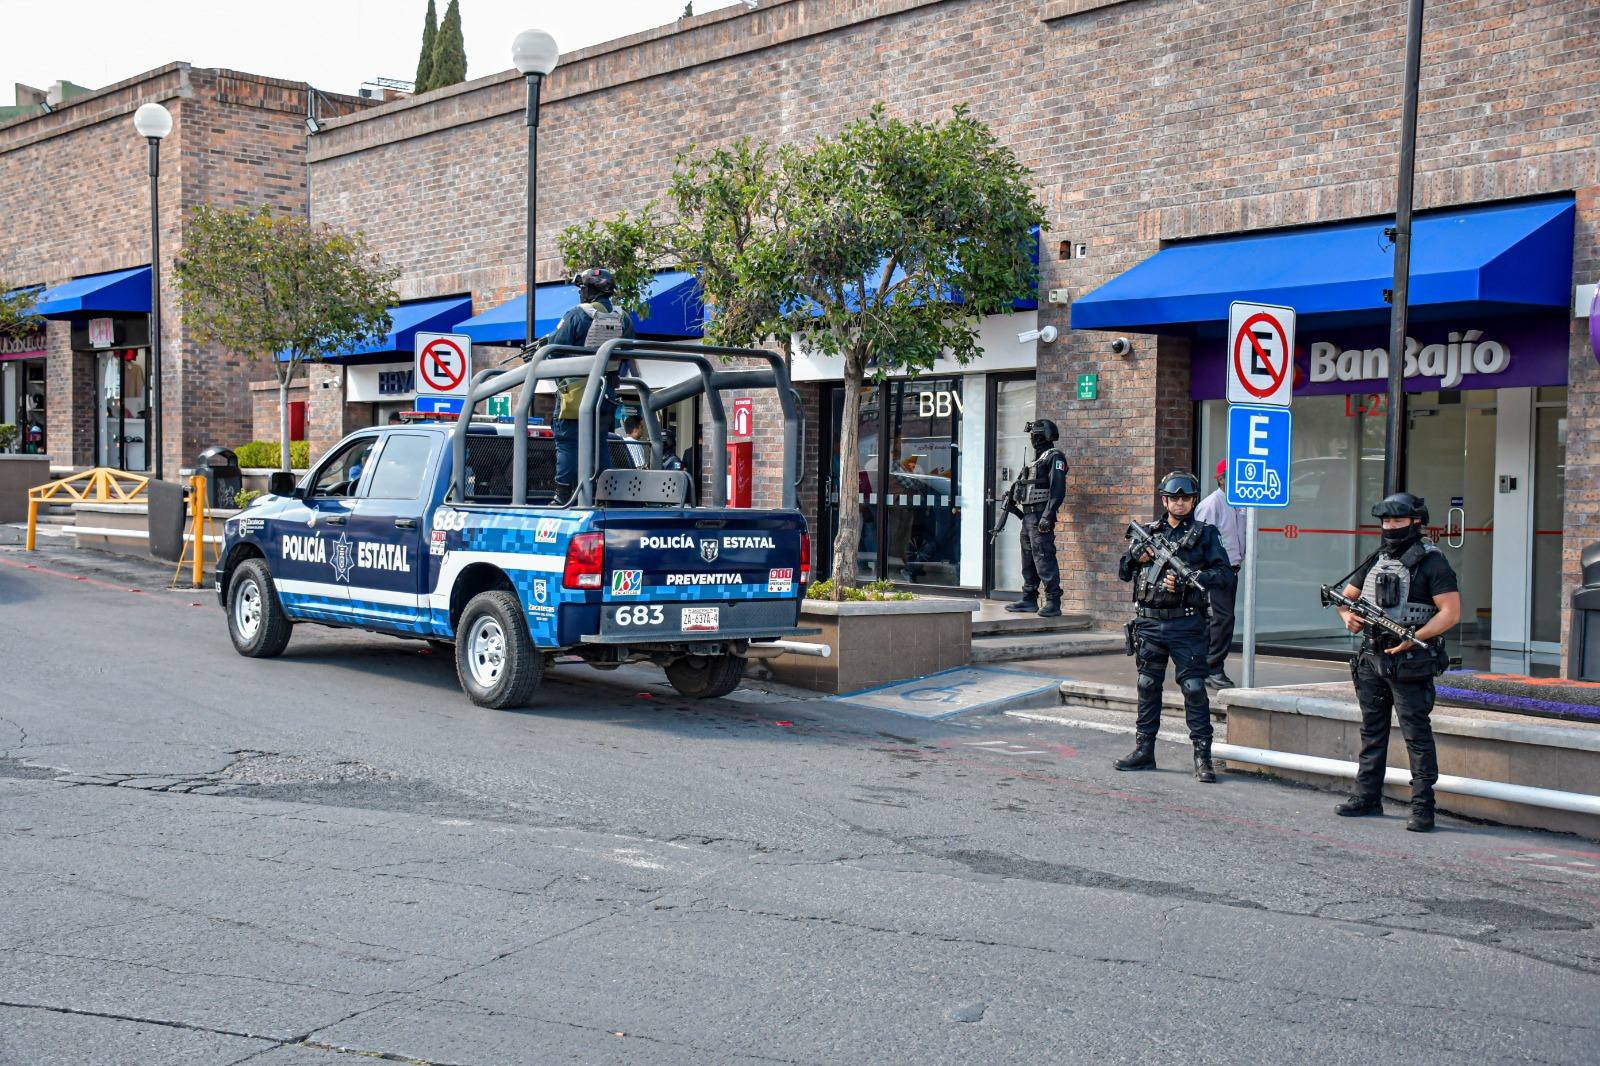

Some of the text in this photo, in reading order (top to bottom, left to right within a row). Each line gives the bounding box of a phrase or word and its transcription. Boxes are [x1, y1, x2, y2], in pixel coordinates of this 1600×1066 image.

[433, 350, 451, 377] E
[1251, 331, 1272, 375] E
[1249, 415, 1269, 455] E
[433, 510, 469, 531] 683
[282, 531, 411, 572] POLICÍA ESTATAL
[640, 533, 776, 549] POLICÍA ESTATAL
[614, 570, 642, 591] 089
[666, 573, 743, 585] PREVENTIVA
[771, 570, 793, 579] 911
[615, 605, 665, 626] 683
